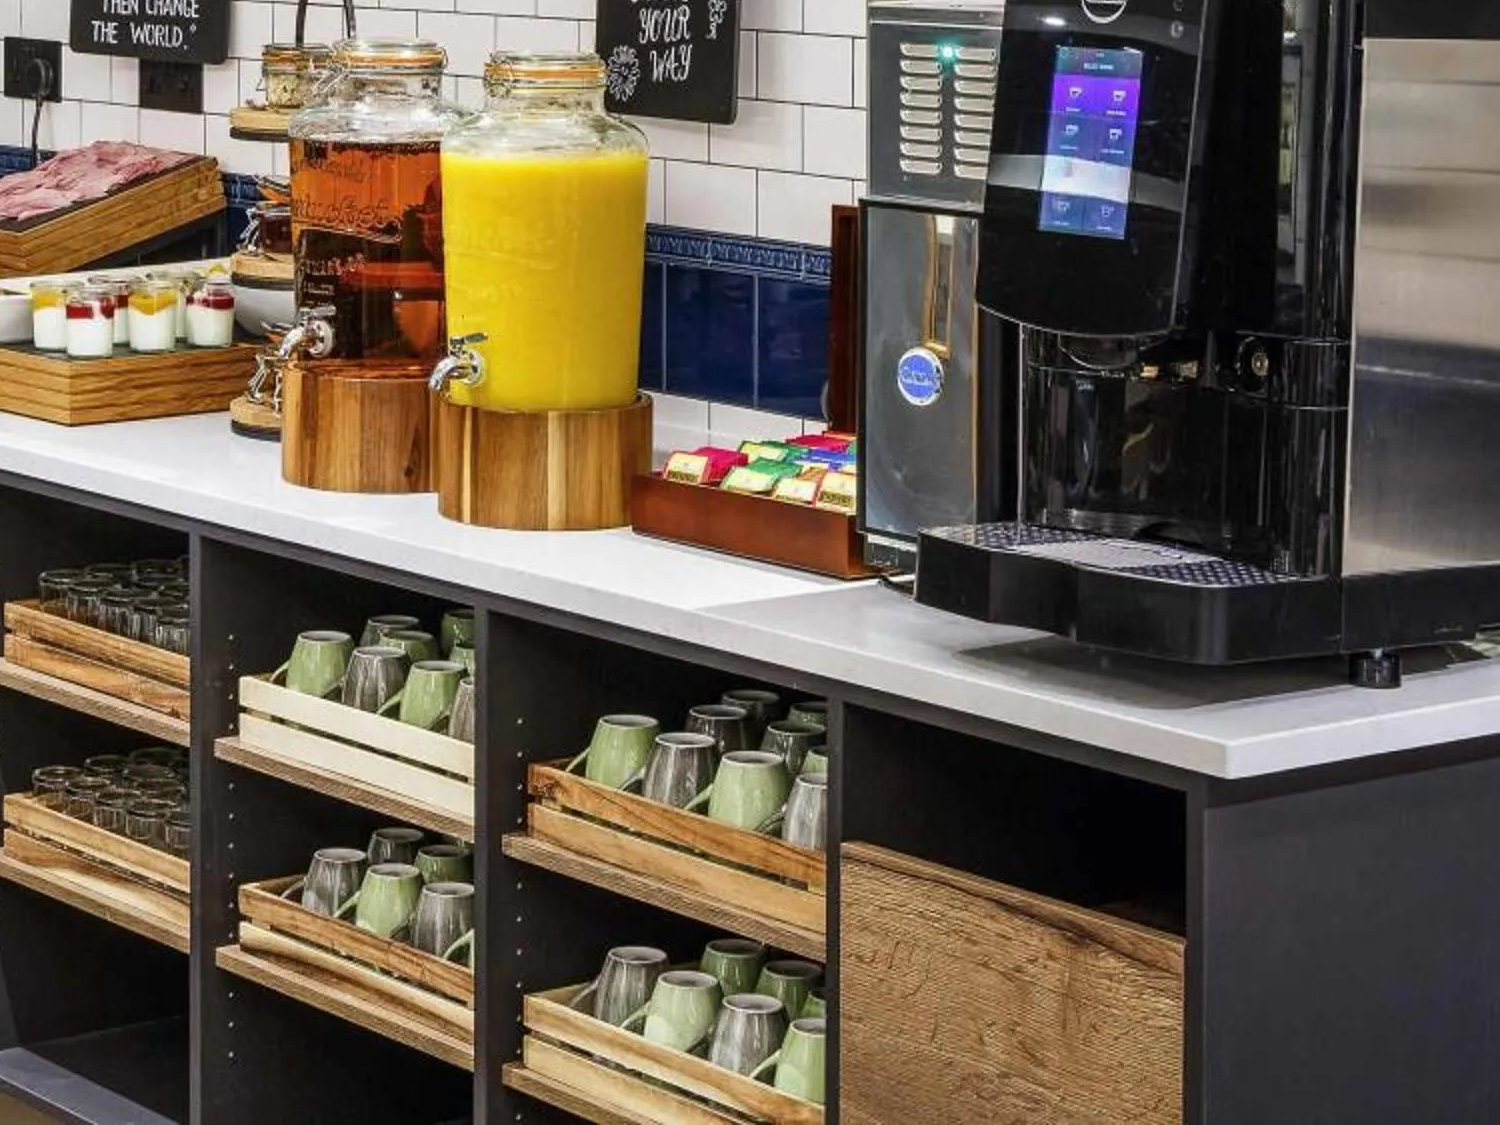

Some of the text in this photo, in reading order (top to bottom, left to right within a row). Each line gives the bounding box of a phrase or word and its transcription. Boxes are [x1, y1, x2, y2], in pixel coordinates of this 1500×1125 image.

[91, 20, 119, 44] THE
[639, 5, 691, 44] YOUR
[650, 44, 693, 83] WAY
